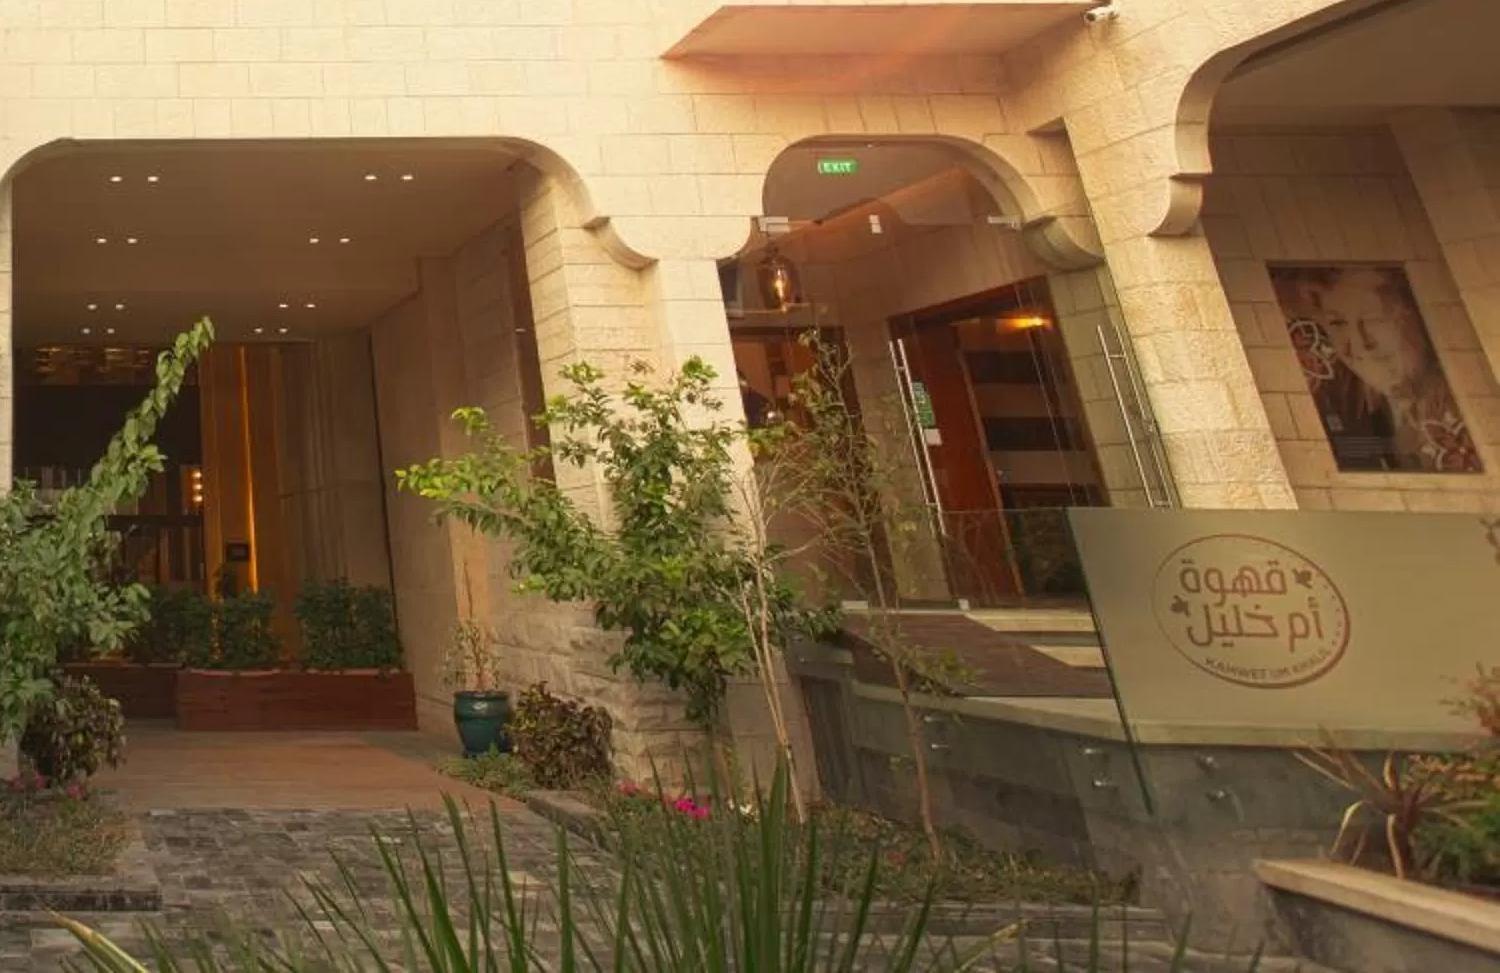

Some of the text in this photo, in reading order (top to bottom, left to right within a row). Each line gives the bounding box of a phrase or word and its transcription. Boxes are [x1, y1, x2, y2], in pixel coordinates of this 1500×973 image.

[822, 161, 852, 174] EXIT
[1180, 559, 1287, 607] قهوة
[1187, 596, 1324, 652] أم خليل
